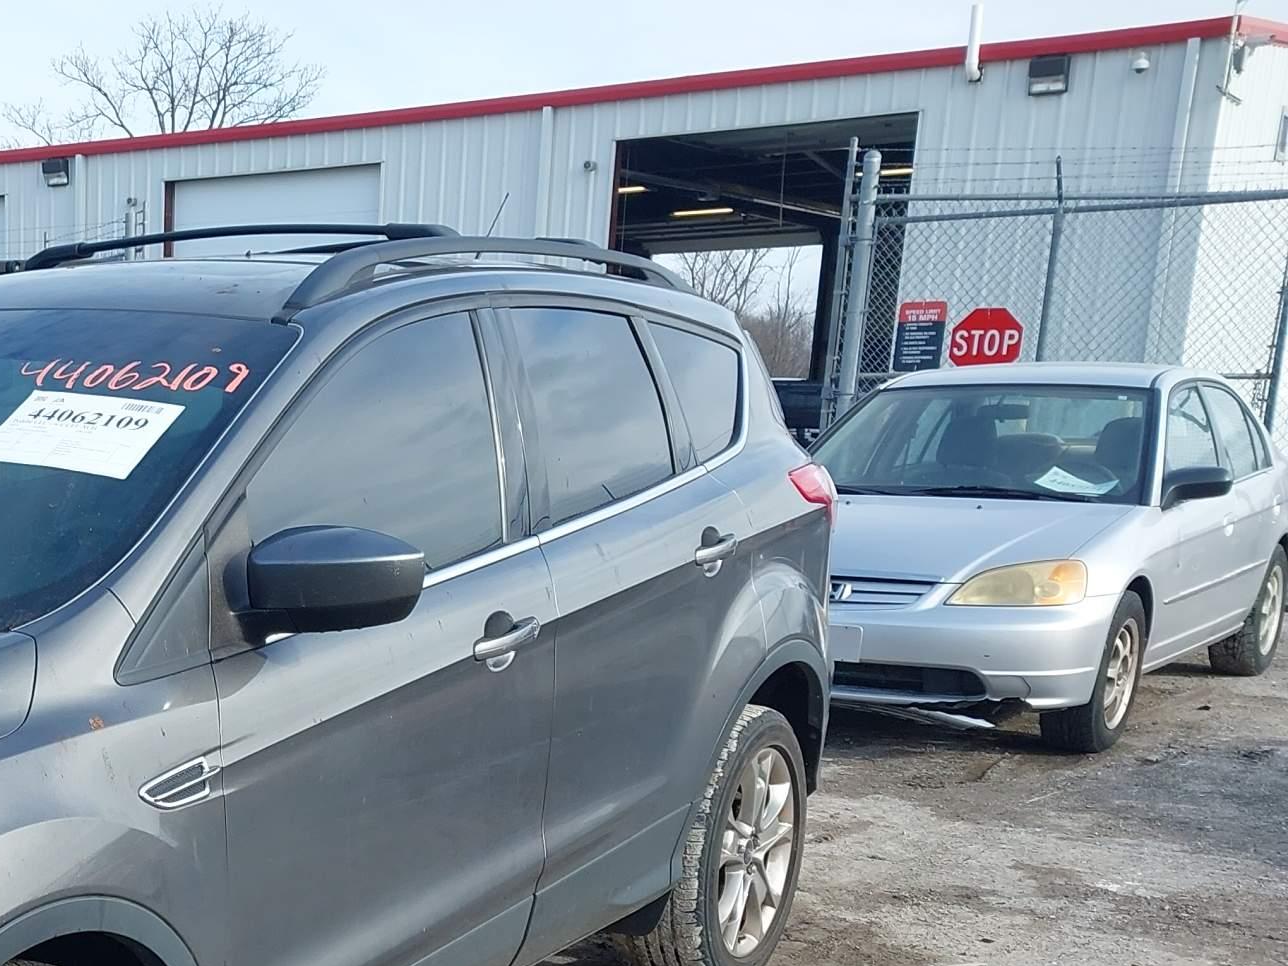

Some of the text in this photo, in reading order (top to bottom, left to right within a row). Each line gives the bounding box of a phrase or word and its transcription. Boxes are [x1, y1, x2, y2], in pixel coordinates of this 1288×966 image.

[952, 329, 1020, 357] STOP
[20, 358, 250, 393] 44062109
[28, 407, 149, 431] 44062109
